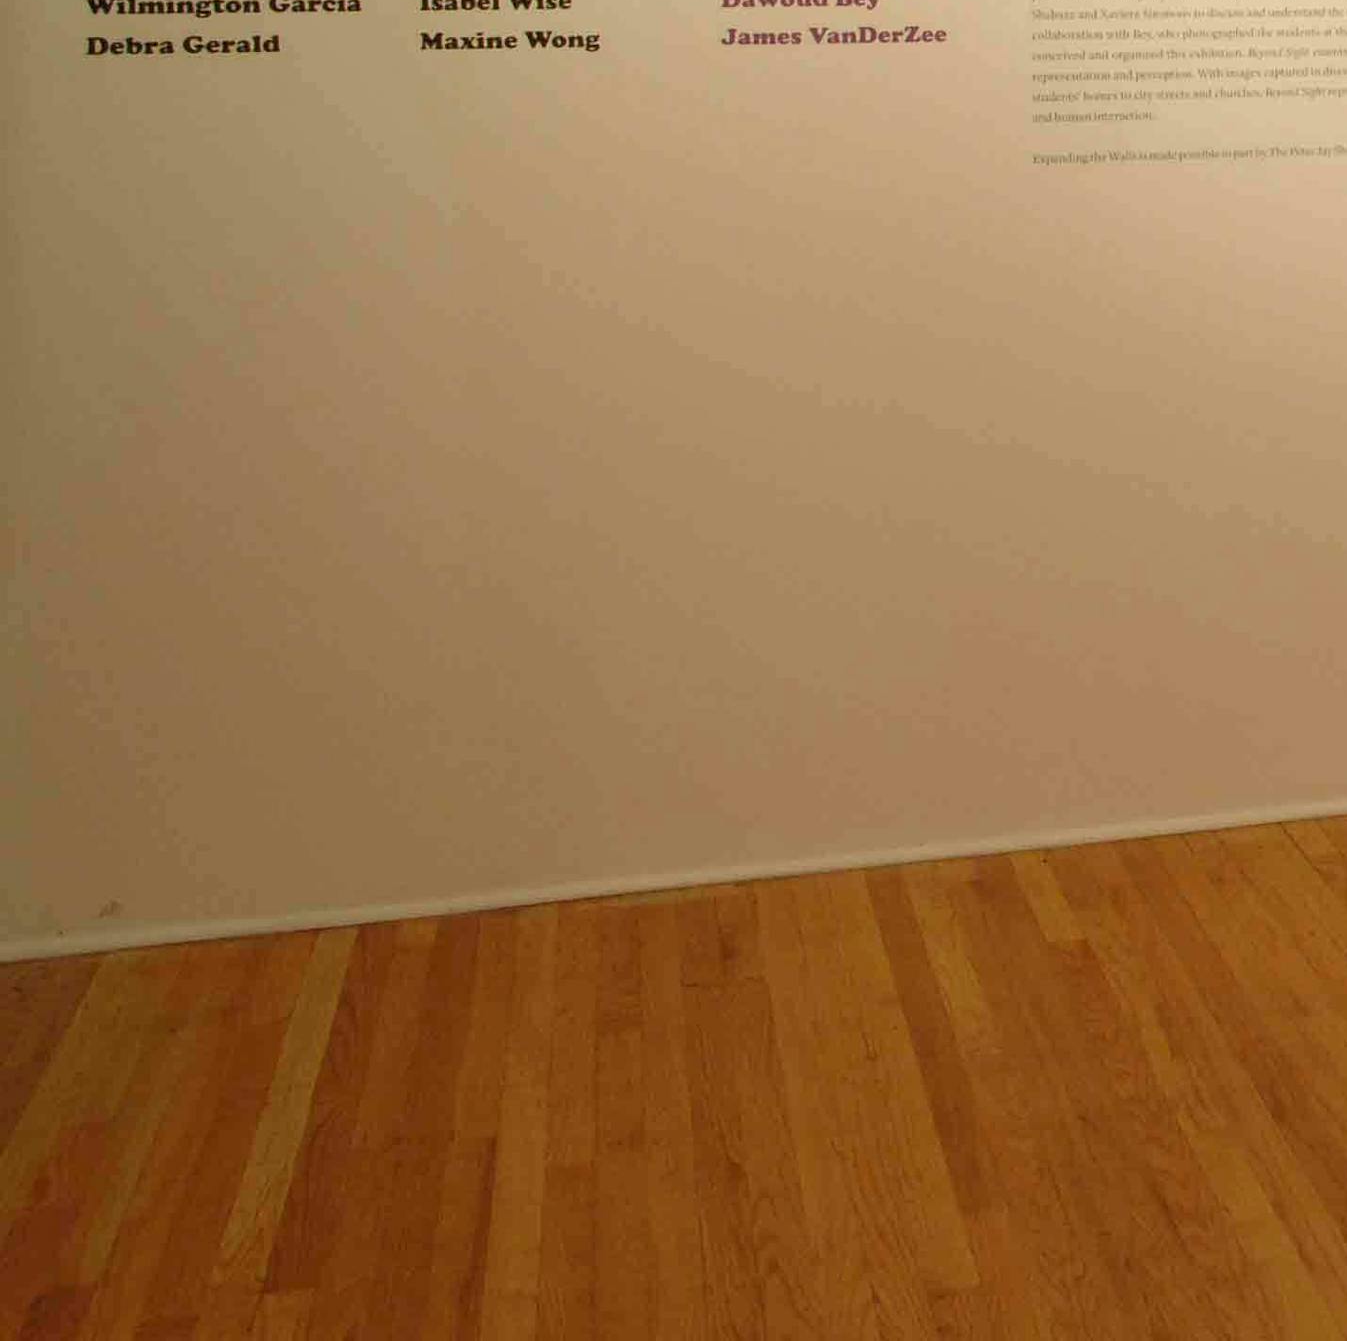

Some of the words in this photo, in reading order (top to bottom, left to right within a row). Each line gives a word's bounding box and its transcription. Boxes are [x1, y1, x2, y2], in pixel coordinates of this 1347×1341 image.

[87, 37, 174, 55] Debra
[183, 35, 280, 53] Gerald
[421, 33, 517, 50] Maxine
[525, 31, 600, 52] Wong
[721, 29, 802, 45] James
[809, 26, 946, 44] VanDerZee
